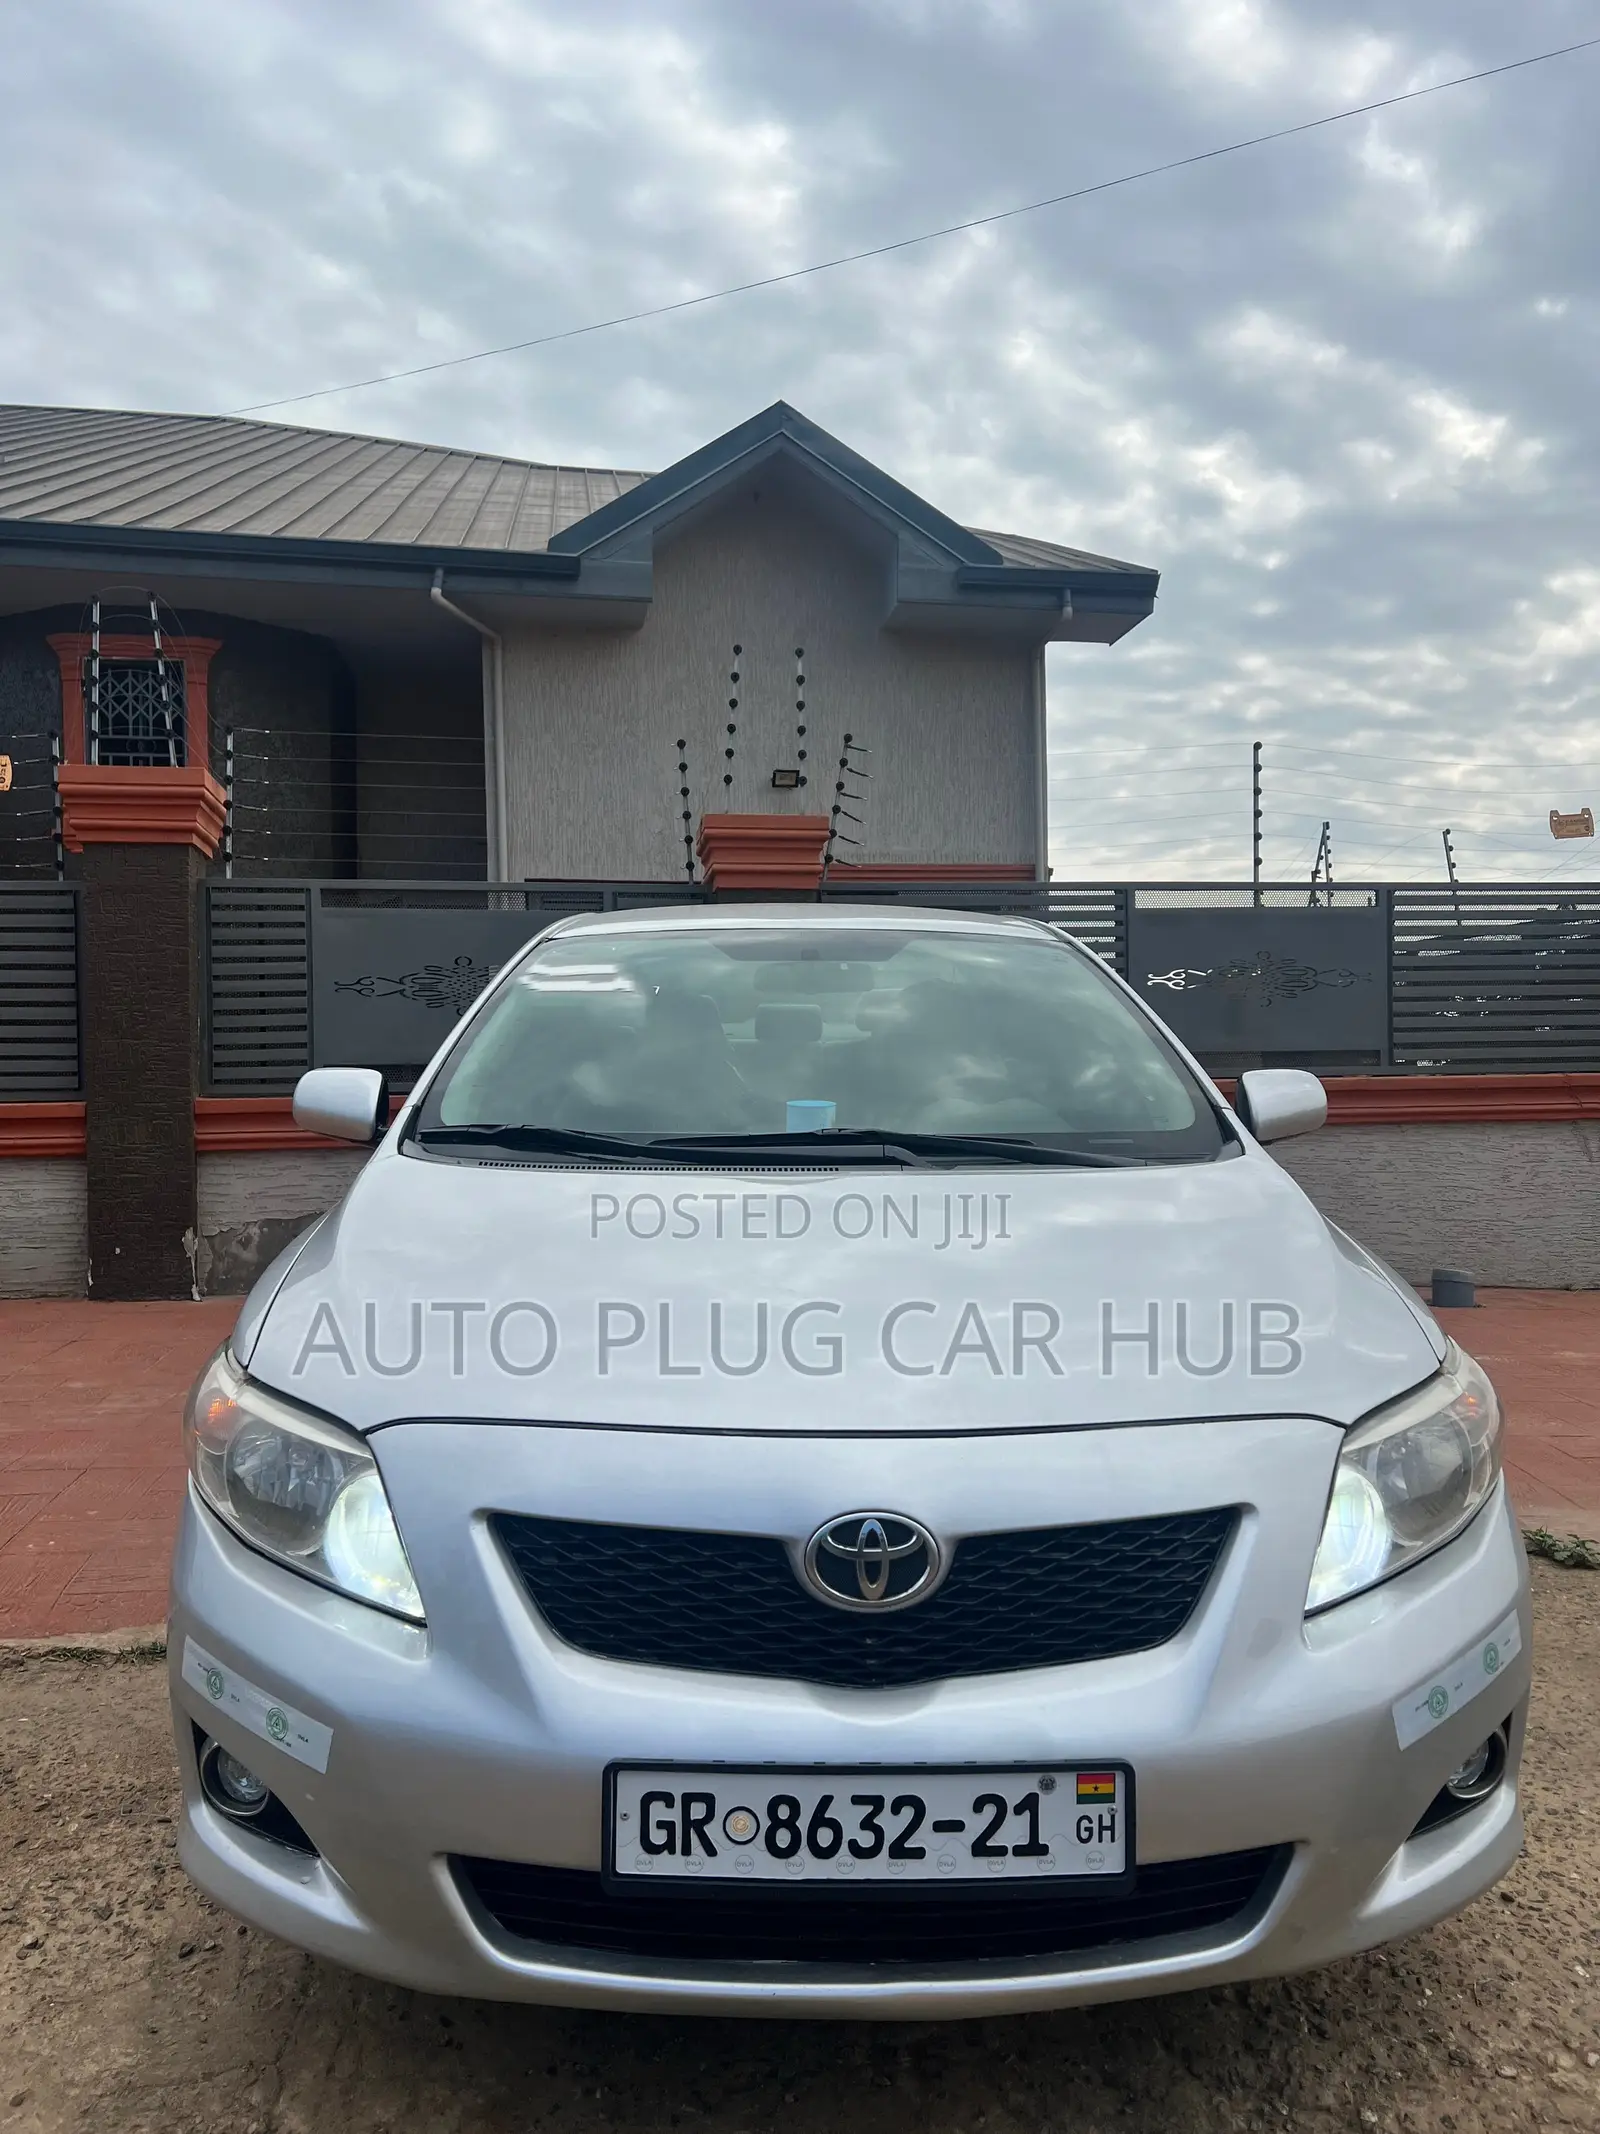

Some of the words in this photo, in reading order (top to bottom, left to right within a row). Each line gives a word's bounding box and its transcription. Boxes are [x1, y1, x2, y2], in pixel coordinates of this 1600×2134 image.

[639, 1791, 718, 1858] GR
[764, 1792, 1050, 1860] 8632-21
[1075, 1814, 1116, 1844] GH
